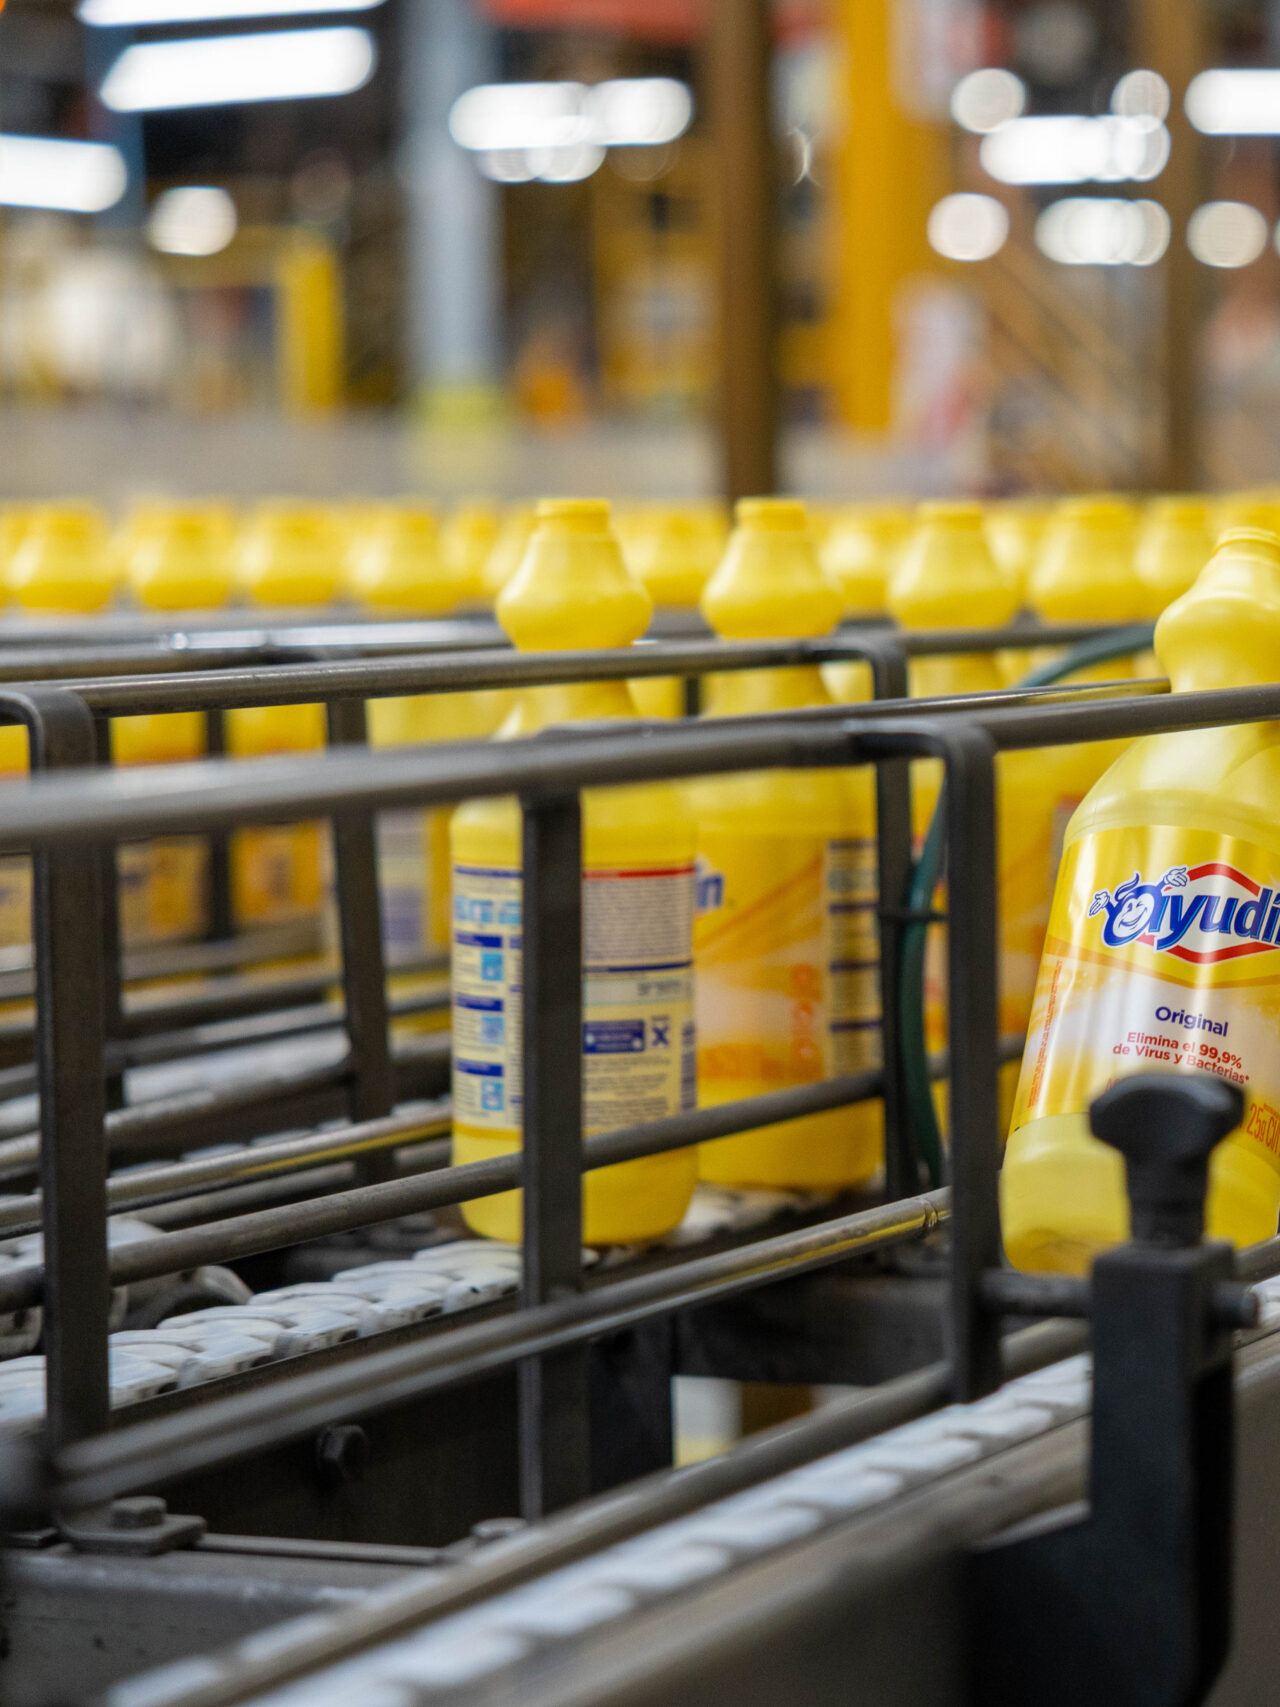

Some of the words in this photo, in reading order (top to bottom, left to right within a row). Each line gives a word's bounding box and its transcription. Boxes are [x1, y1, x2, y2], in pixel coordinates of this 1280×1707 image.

[1155, 1006, 1229, 1037] Original
[1112, 1043, 1130, 1055] de
[1135, 1044, 1170, 1061] Virus
[1173, 1053, 1183, 1065] y
[1127, 1031, 1179, 1049] Elimina
[1182, 1041, 1196, 1053] el
[1199, 1044, 1243, 1070] 99,9%
